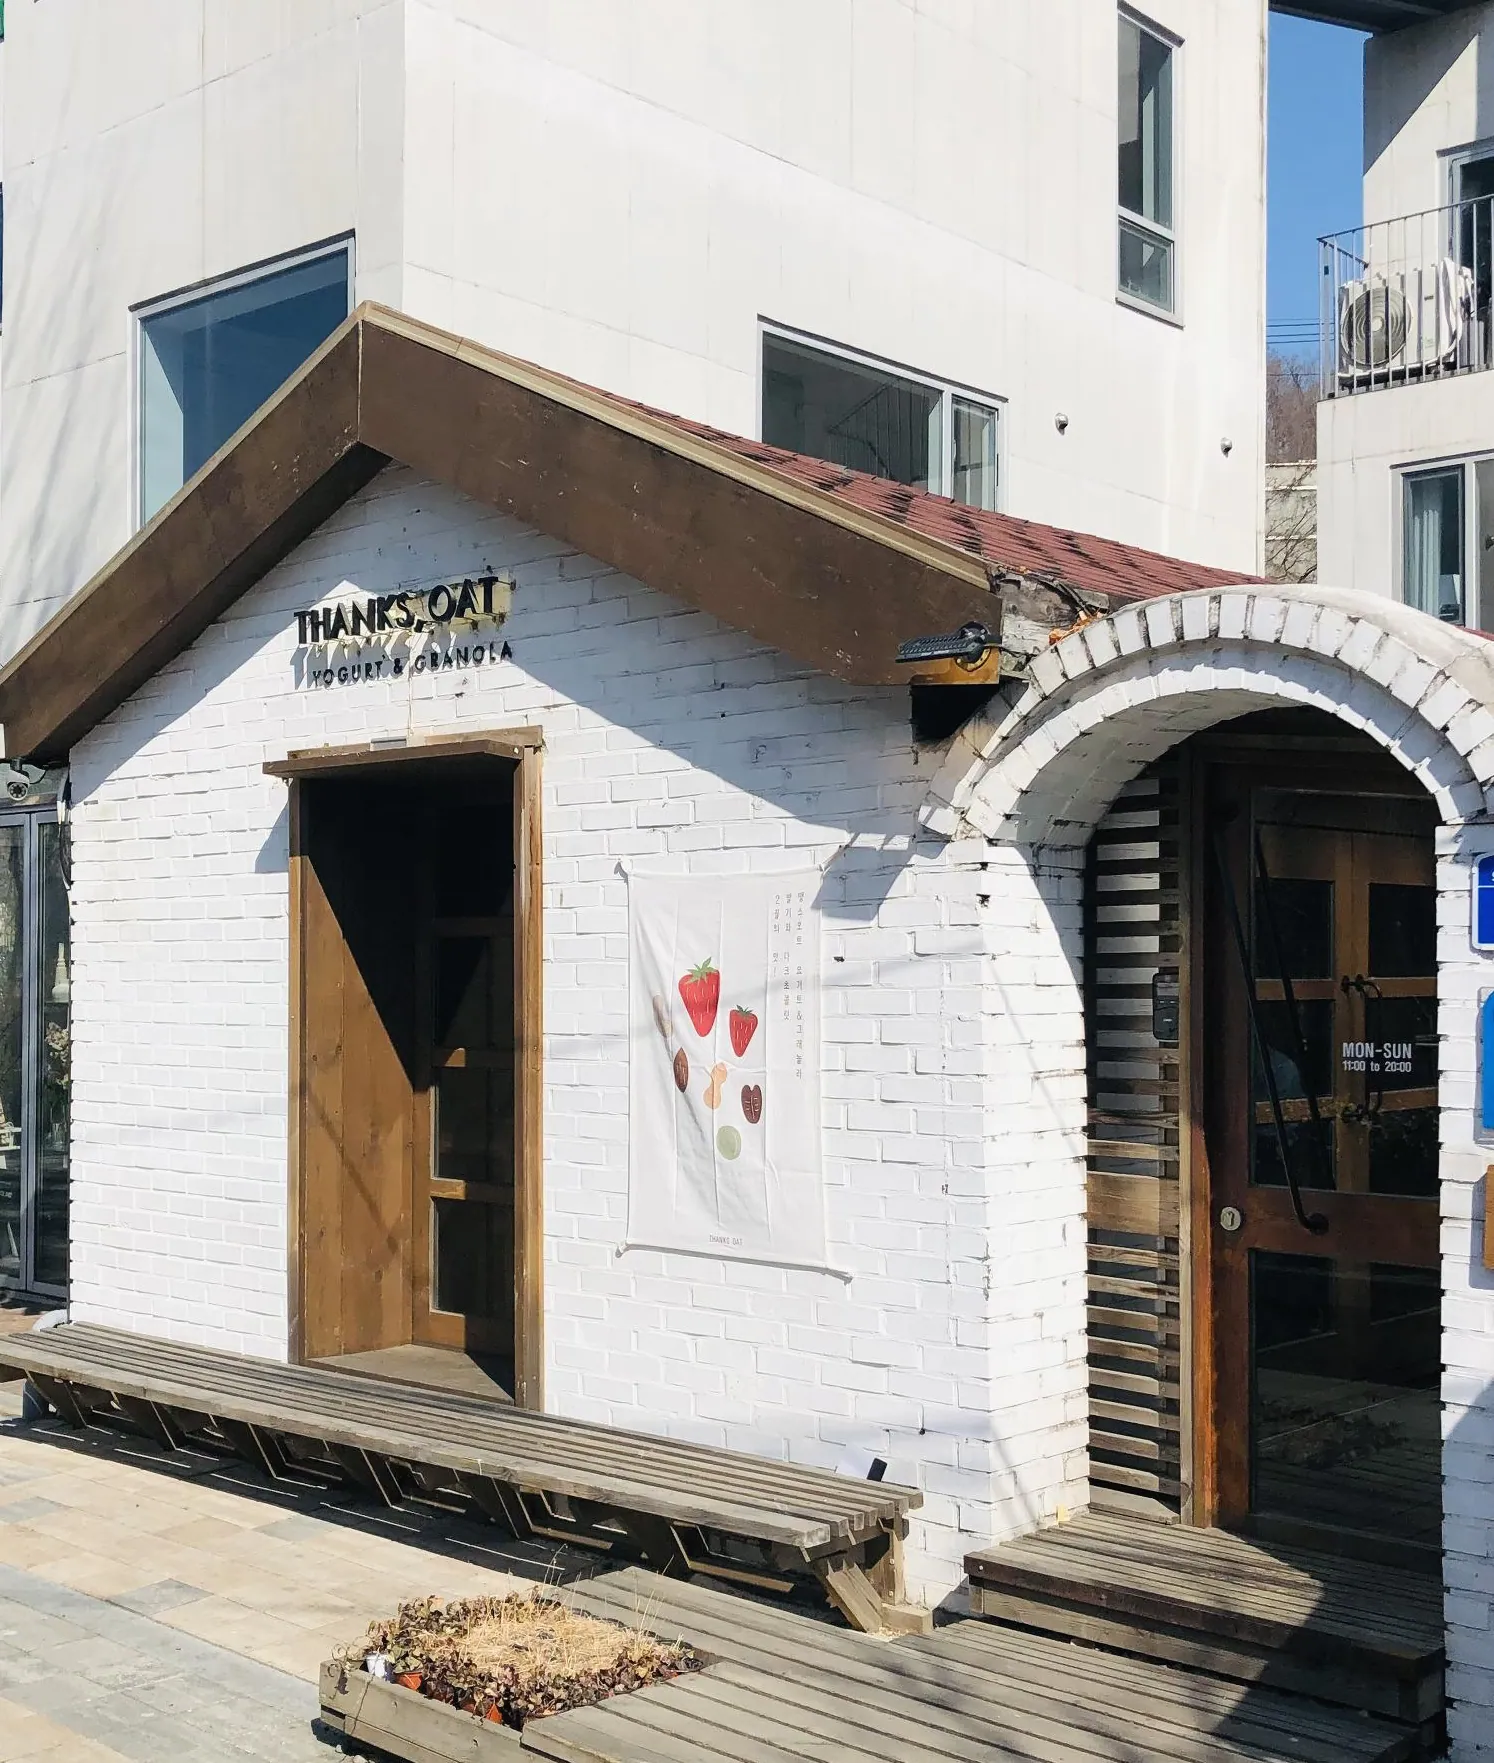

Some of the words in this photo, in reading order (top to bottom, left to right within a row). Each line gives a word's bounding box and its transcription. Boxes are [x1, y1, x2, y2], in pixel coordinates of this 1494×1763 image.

[428, 576, 499, 622] OAT
[312, 659, 384, 687] YOGURT
[393, 657, 404, 675] &
[414, 641, 513, 673] GRANOLA
[1342, 1042, 1412, 1059] MON-SUN
[1342, 1060, 1366, 1072] 11:00
[1370, 1060, 1380, 1072] to
[1384, 1061, 1412, 1073] 20:00
